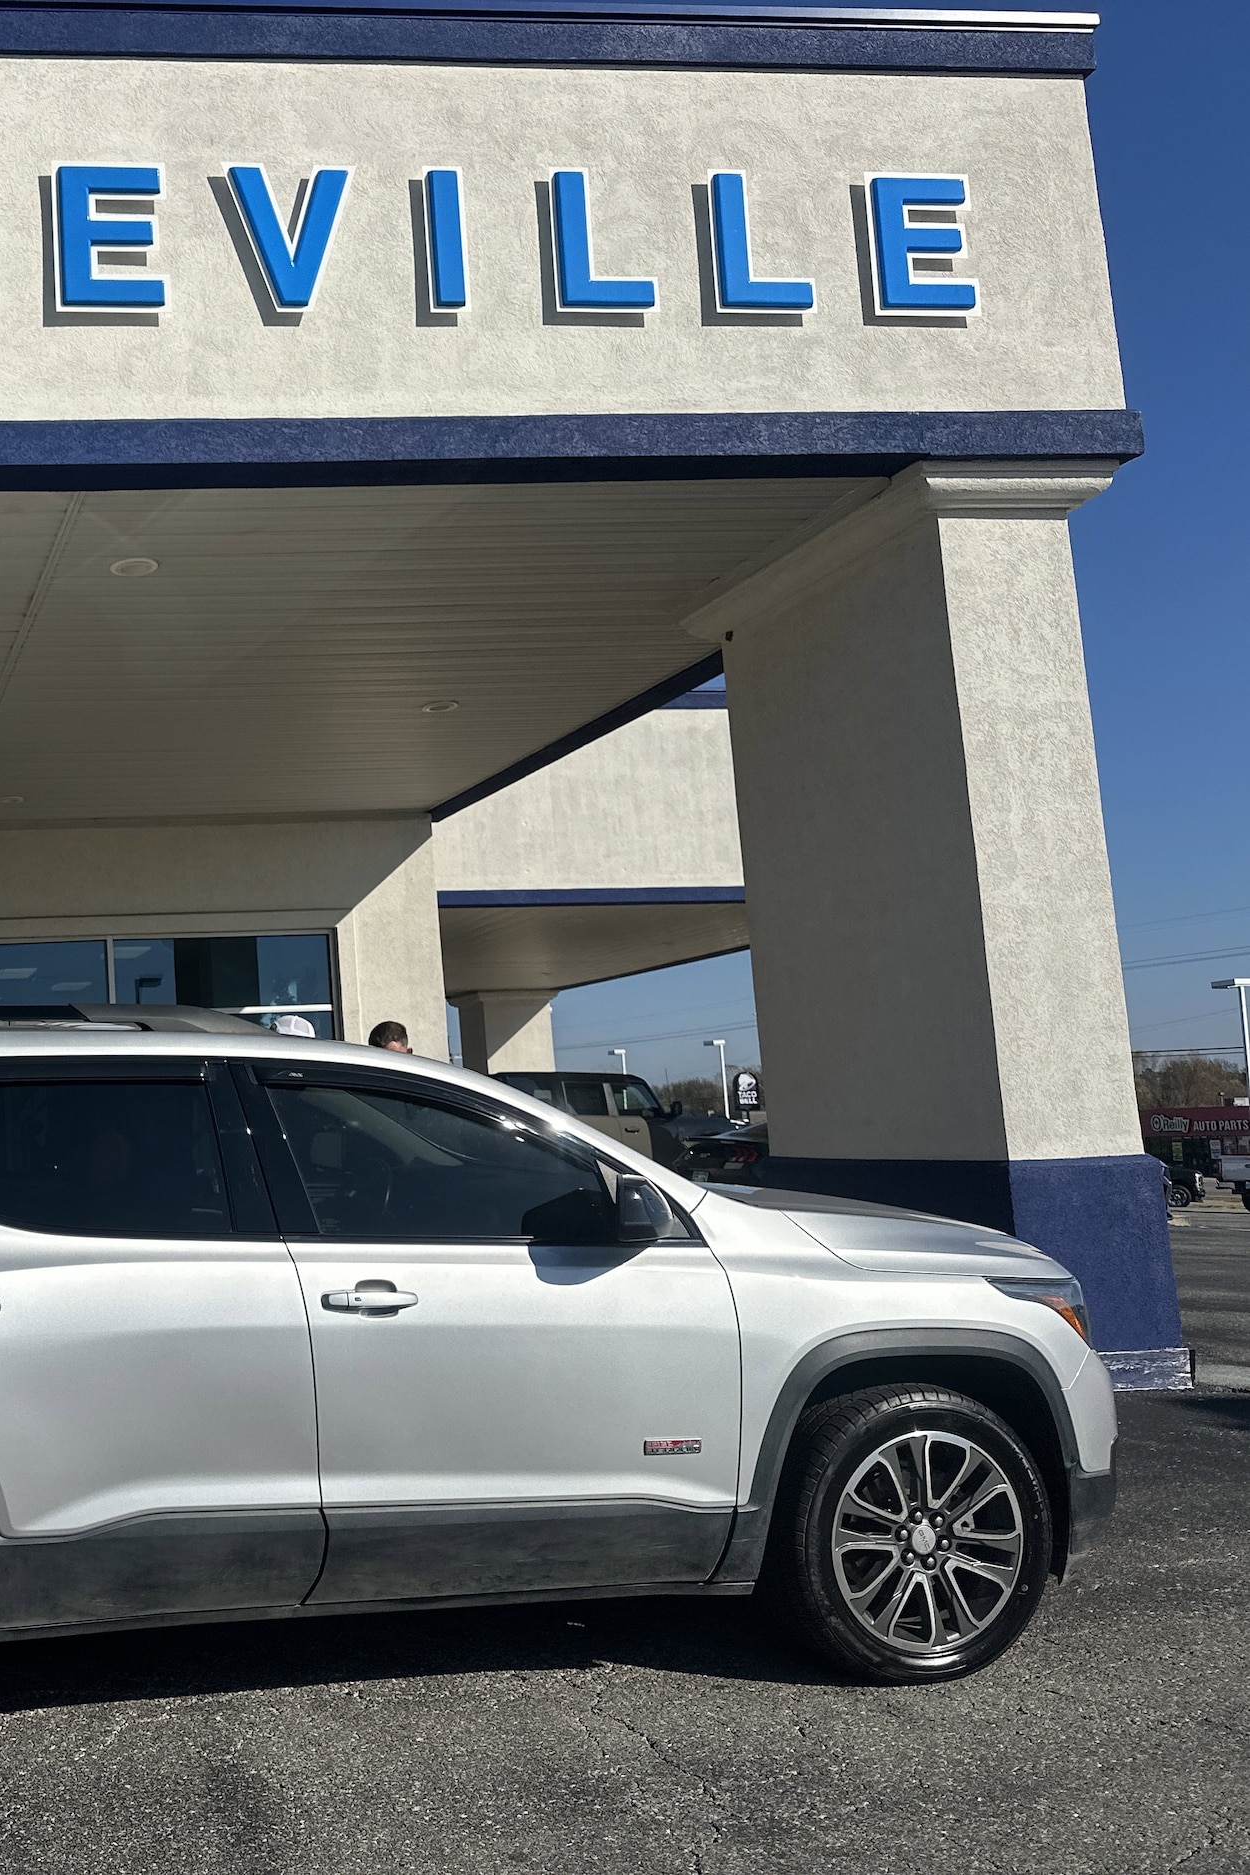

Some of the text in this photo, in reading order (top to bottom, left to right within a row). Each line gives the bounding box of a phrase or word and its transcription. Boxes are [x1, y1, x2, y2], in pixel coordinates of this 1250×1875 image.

[737, 1090, 758, 1099] TACO
[1150, 1114, 1250, 1133] O'Reilly AUTO PARTS
[918, 1529, 931, 1550] GMC
